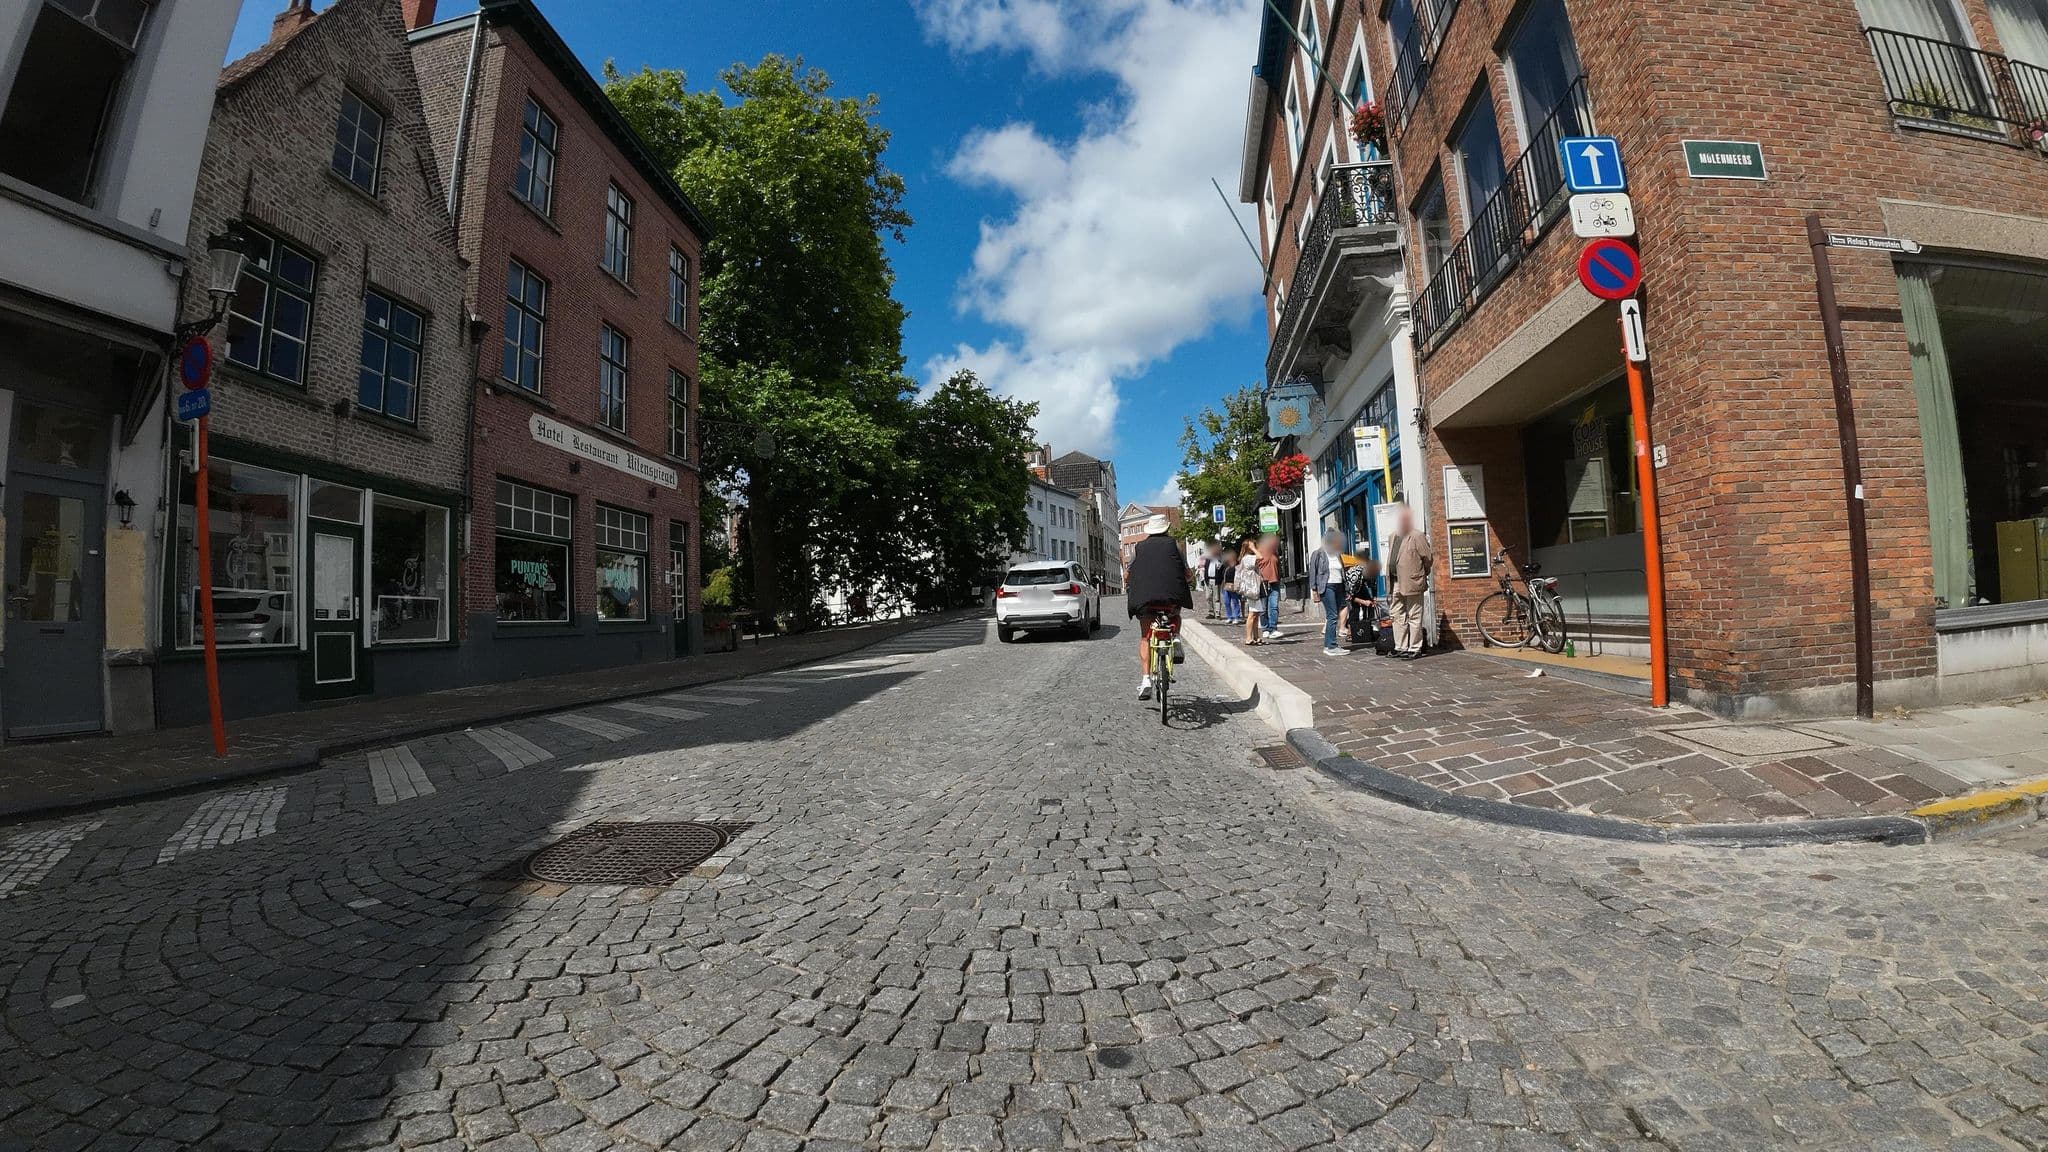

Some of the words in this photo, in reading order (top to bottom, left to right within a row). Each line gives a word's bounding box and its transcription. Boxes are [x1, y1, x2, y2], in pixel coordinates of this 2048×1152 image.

[1699, 152, 1752, 166] MOLENMEERS
[537, 419, 564, 444] Hotel
[573, 434, 619, 464] Restaurant
[626, 452, 676, 486] Uilenspiegel
[1576, 436, 1604, 456] HOUSE
[1657, 449, 1663, 463] 5
[511, 559, 549, 577] PUNTA'S
